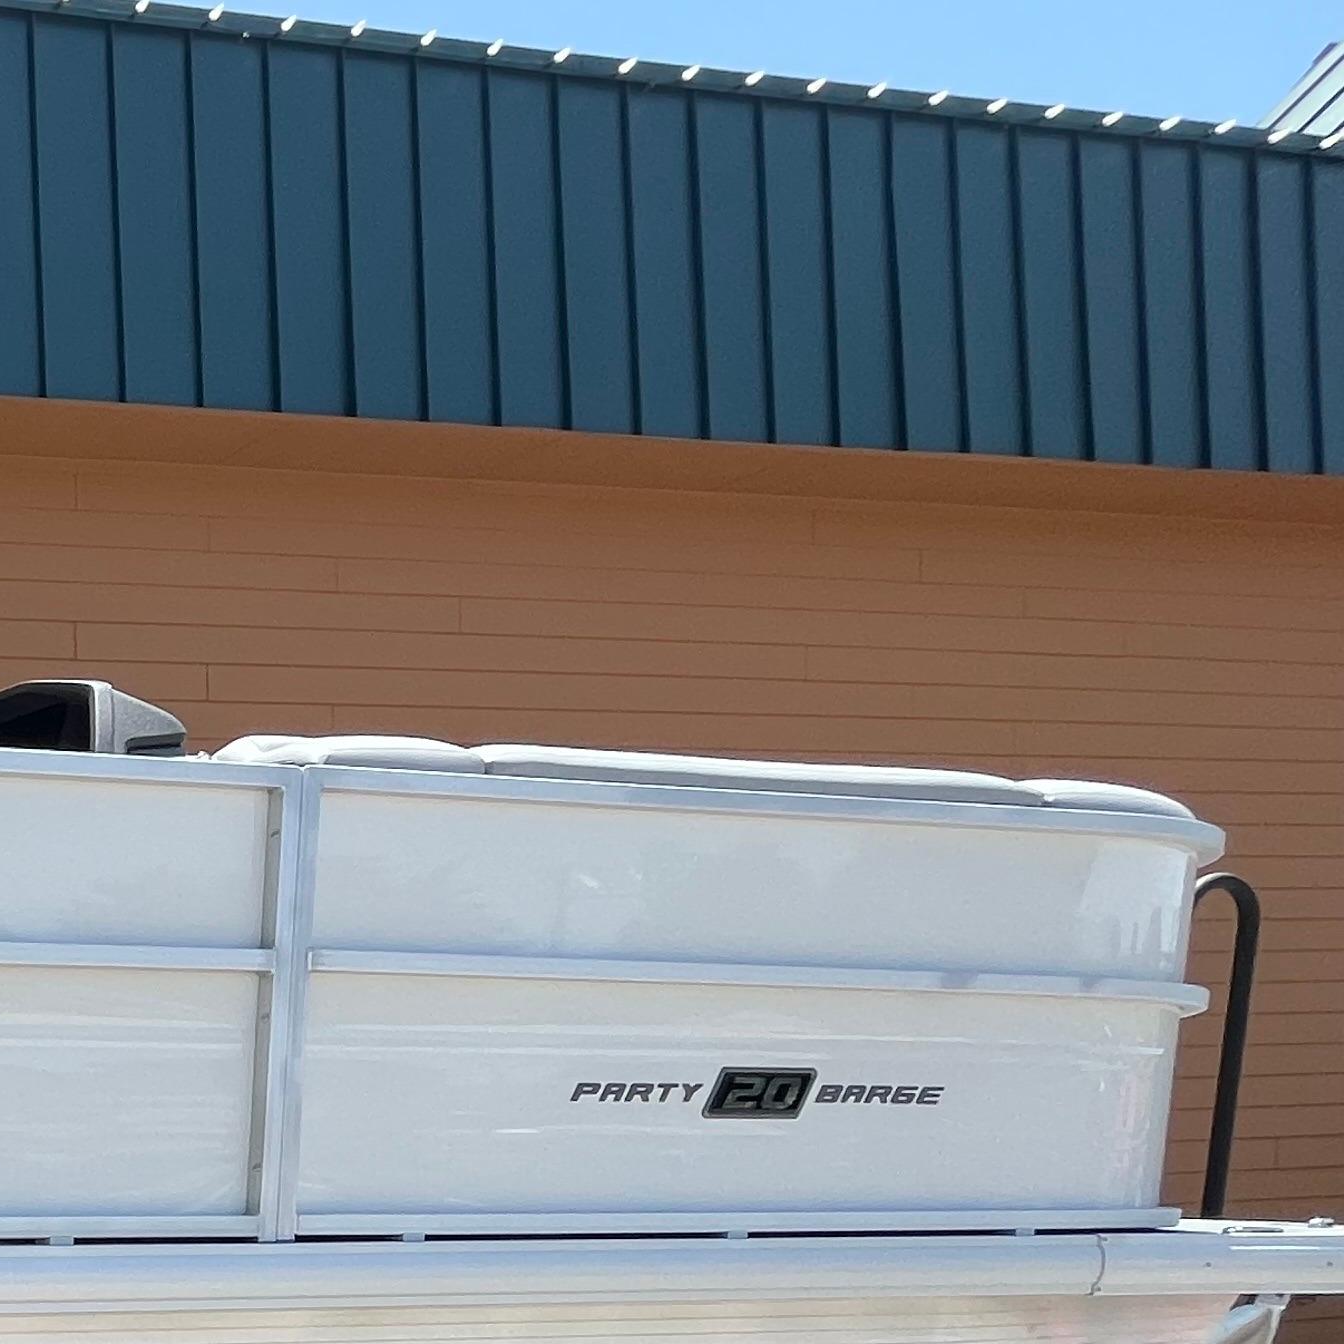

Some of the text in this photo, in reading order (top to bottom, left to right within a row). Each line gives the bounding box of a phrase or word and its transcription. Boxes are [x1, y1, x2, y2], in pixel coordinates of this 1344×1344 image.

[569, 1075, 946, 1110] PARTY 20 BARGE
